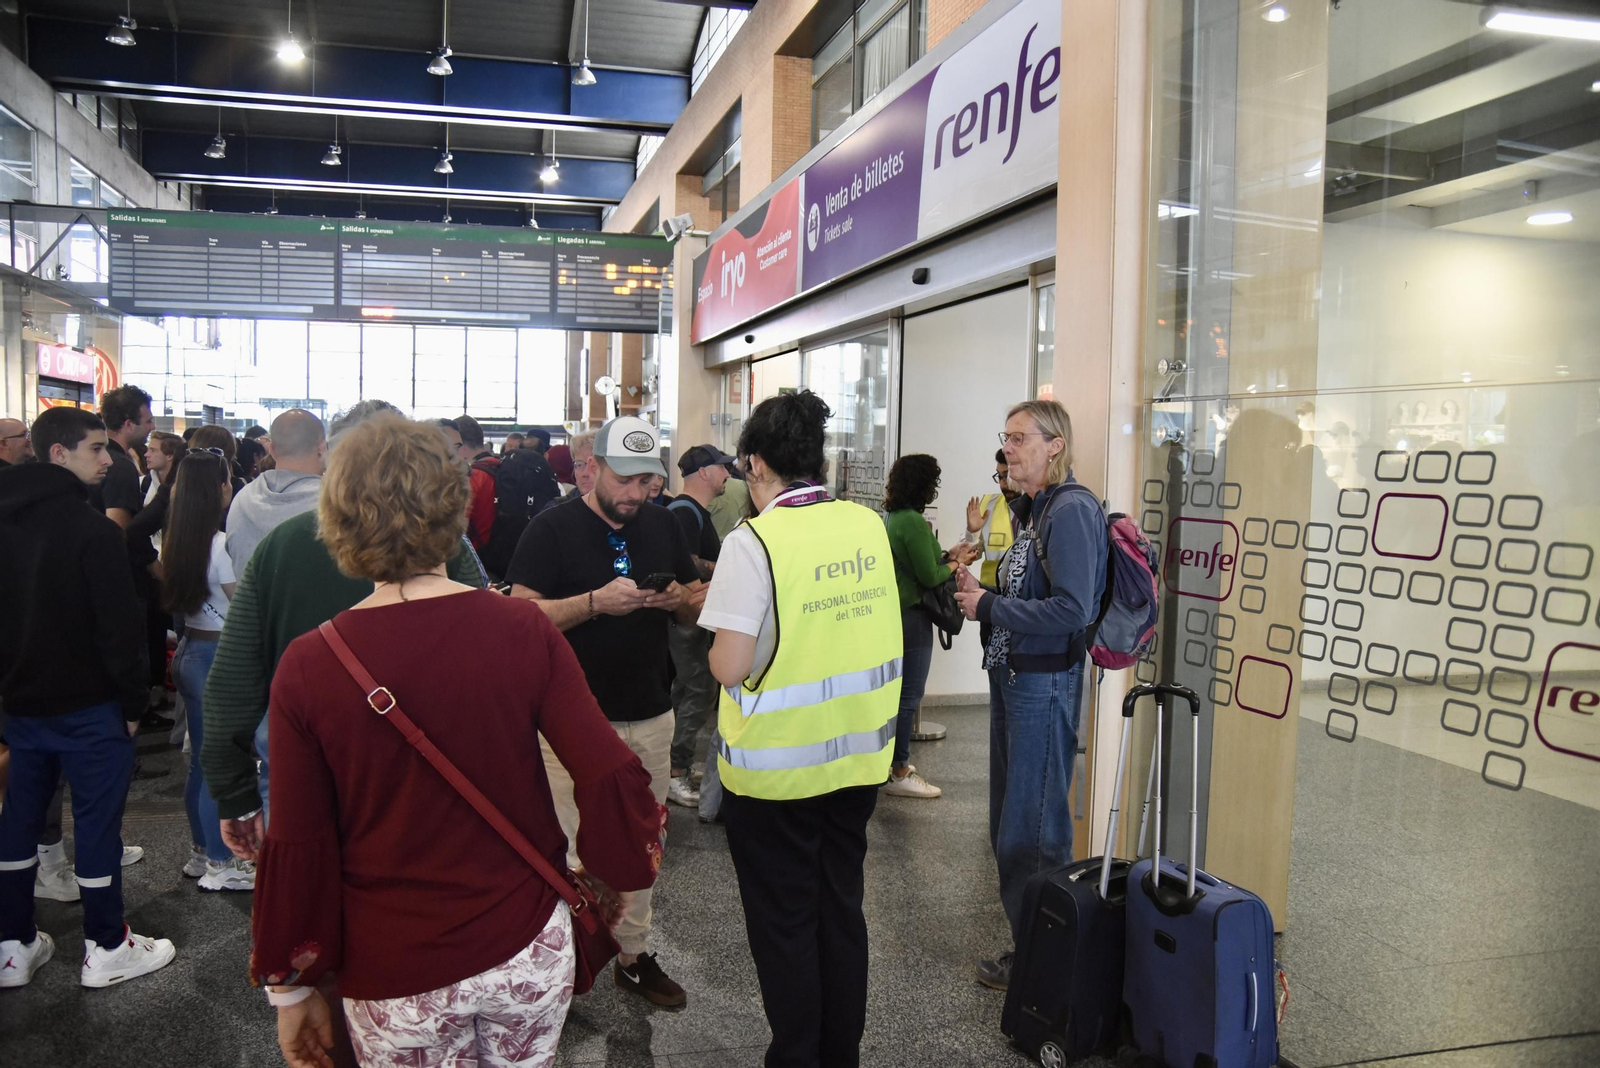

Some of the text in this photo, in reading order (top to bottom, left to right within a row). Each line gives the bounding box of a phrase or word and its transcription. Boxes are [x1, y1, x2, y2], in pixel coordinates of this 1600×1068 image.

[933, 22, 1061, 171] renfe
[825, 150, 904, 218] Venta de billetes
[110, 214, 136, 222] Salidas
[341, 225, 365, 233] Salidas
[557, 236, 584, 245] Llegadas
[824, 223, 841, 245] Tickets
[720, 250, 746, 307] iryo
[814, 547, 877, 584] renfe
[1169, 541, 1234, 580] renfe
[802, 586, 887, 614] PERSONAL COMERCIAL
[835, 604, 873, 621] del TREN
